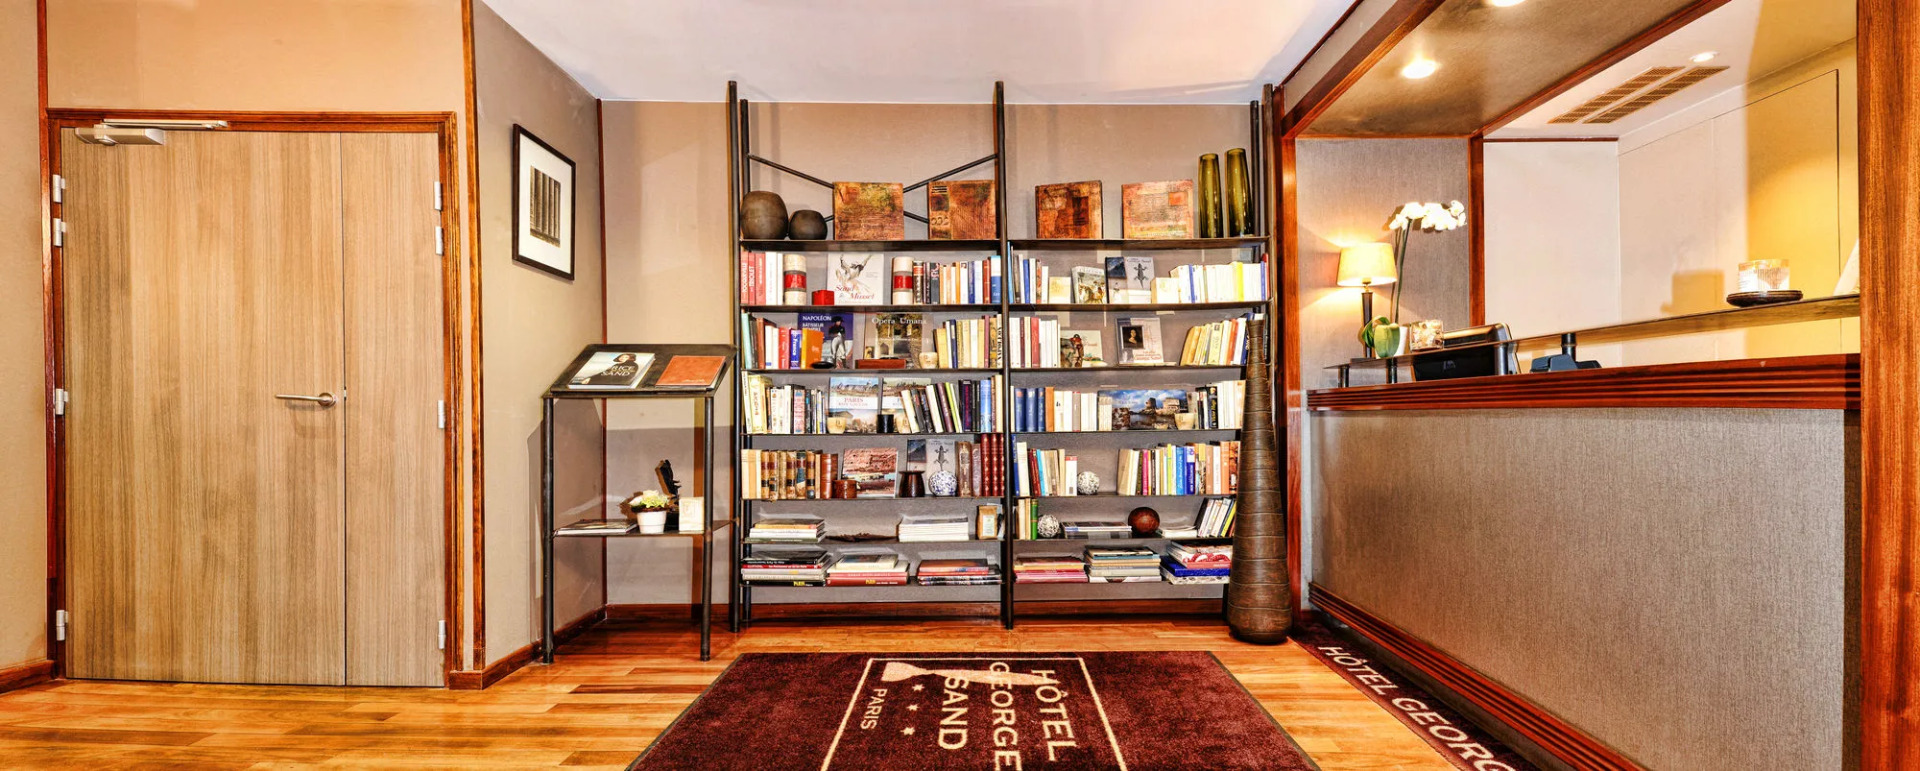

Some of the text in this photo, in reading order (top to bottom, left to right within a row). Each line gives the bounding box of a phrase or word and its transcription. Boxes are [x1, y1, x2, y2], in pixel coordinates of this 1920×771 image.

[871, 317, 896, 325] Opera
[1317, 646, 1399, 695] HÔTEL
[860, 687, 888, 730] PARIS
[937, 676, 970, 750] SAND
[989, 662, 1023, 771] GEORGE
[1031, 669, 1078, 762] HÔTEL
